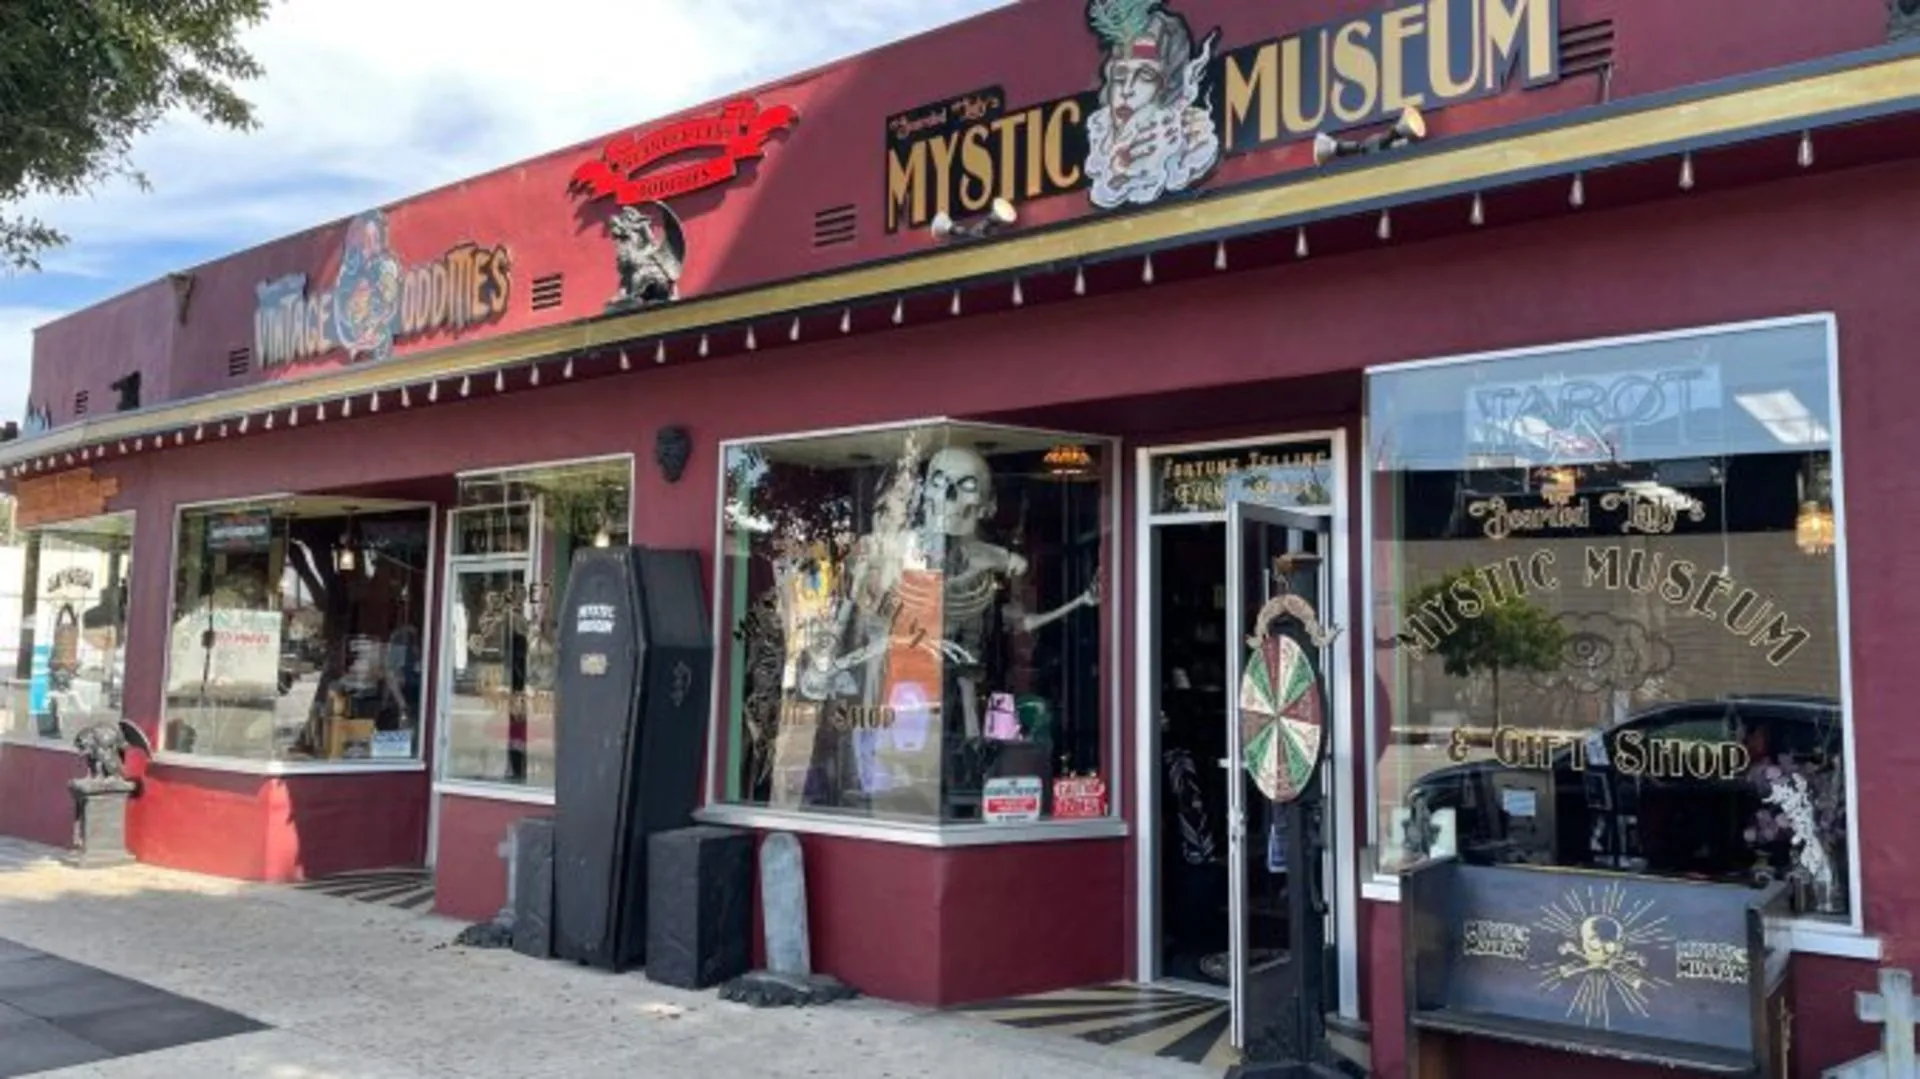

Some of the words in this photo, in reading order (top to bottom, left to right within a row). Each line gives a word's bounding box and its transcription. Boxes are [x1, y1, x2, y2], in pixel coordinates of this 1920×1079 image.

[888, 100, 1081, 231] MYSTIC
[1225, 0, 1552, 152] MUSEUM
[254, 293, 335, 368] VINTAGE
[401, 242, 510, 333] ODDITIES
[1475, 368, 1704, 424] TAROT
[1163, 457, 1240, 480] FORTUNE
[1468, 494, 1591, 540] Bearded
[1397, 548, 1560, 662] MYSTIC
[1584, 545, 1811, 667] MUSEUM
[1448, 727, 1472, 764] &
[1493, 726, 1586, 772] GIFT
[1615, 729, 1752, 779] SHOP
